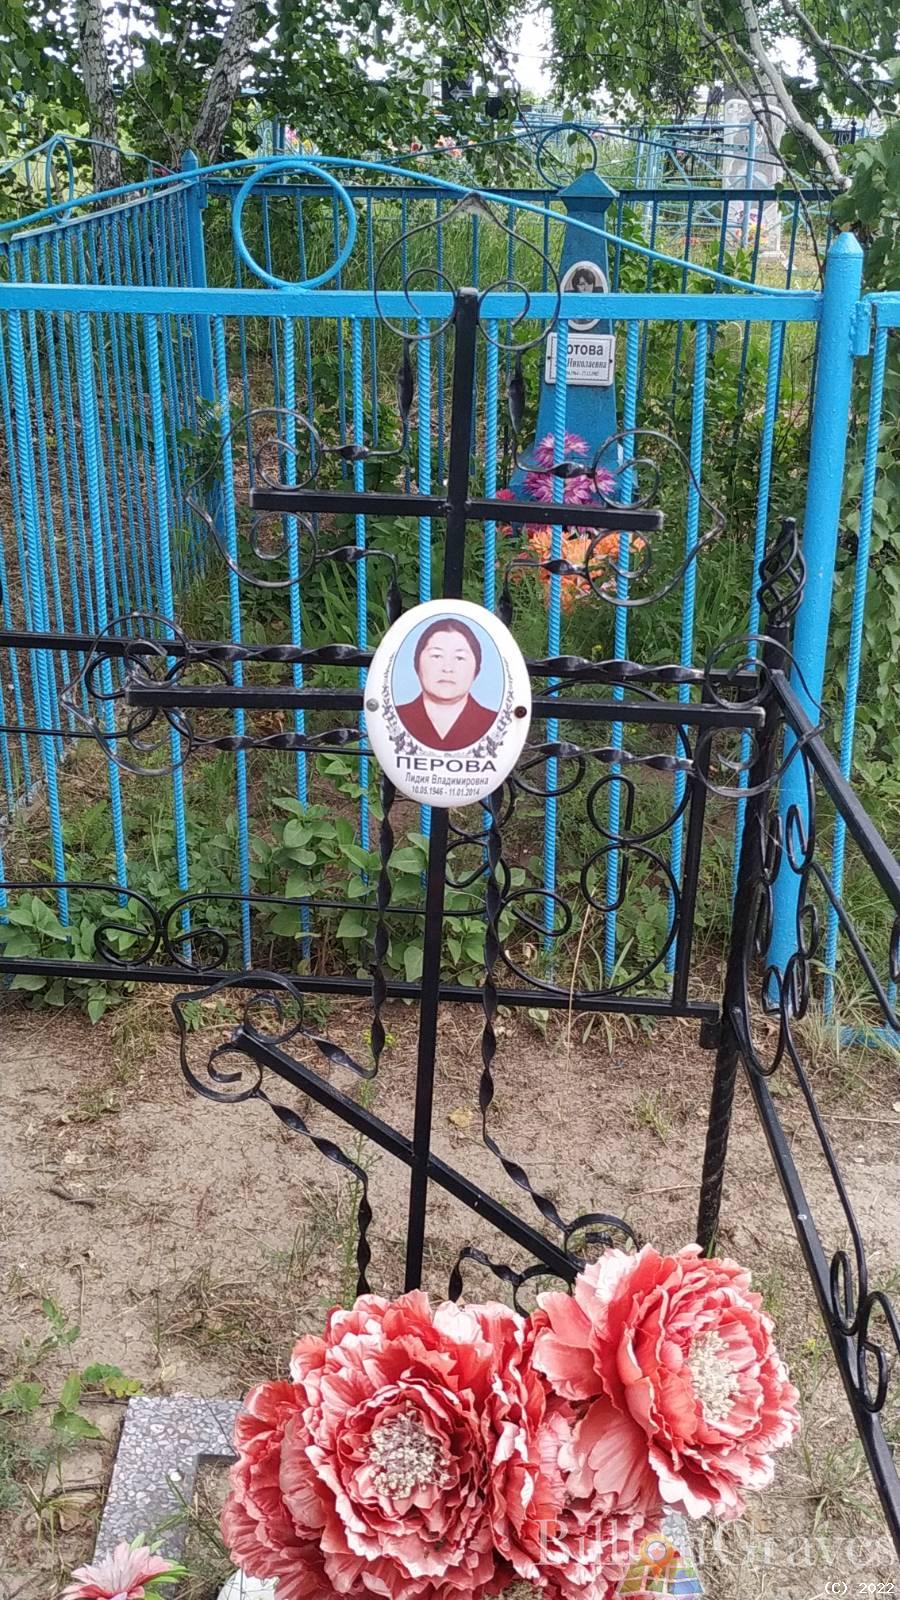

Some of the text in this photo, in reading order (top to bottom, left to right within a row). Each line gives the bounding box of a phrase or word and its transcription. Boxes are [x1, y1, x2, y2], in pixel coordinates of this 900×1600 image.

[566, 344, 604, 355] отова
[396, 756, 497, 773] ПЕРОВА
[405, 773, 489, 786] Лидия Владимировна
[411, 786, 444, 795] 10.05.1946
[448, 787, 480, 796] 11.01.2014
